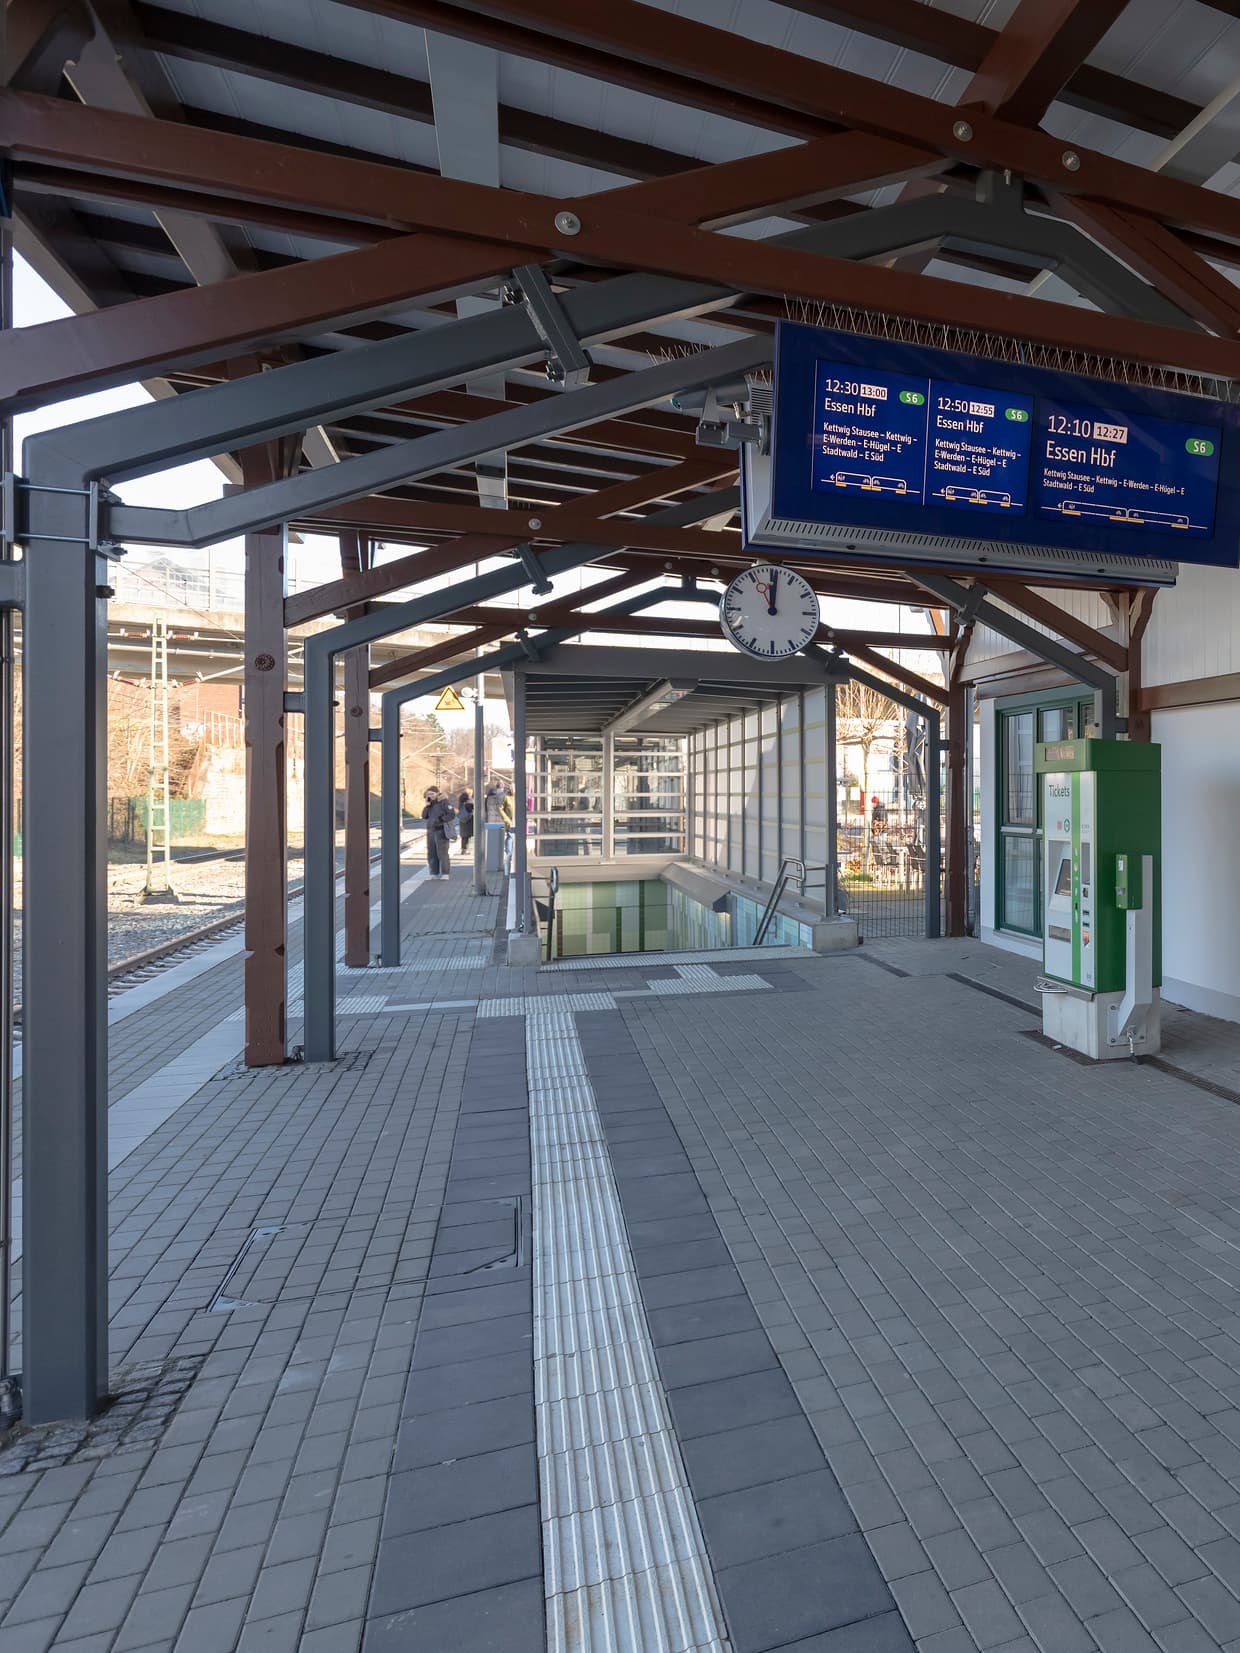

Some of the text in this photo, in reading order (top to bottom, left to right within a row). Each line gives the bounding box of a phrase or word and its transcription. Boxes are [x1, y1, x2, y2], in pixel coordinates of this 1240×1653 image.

[826, 379, 886, 397] 12:30 13:00
[825, 398, 876, 416] Essen Hbf
[938, 398, 992, 415] 12:50 12:55
[824, 423, 850, 435] Kettwig
[852, 426, 878, 438] Stausee
[886, 432, 911, 444] Kettwig
[937, 416, 984, 433] Essen Hbf
[1048, 416, 1124, 439] 12:10 12:27
[824, 434, 856, 446] E-Werden
[864, 440, 889, 452] E-Hügel
[936, 439, 960, 451] Kettwig
[961, 442, 986, 453] Stausee
[993, 448, 1016, 459] Kettwig
[823, 446, 857, 458] Stadtwald
[871, 452, 884, 461] Süd
[935, 450, 965, 461] E-Werden
[972, 455, 995, 466] E-Hügel
[1046, 441, 1116, 467] Essen Hbf
[934, 461, 966, 472] Stadtwald
[978, 466, 990, 476] Süd
[1043, 480, 1072, 490] Stadtwald
[1083, 484, 1094, 493] Süd
[1044, 469, 1066, 480] Kettwig
[1067, 472, 1090, 482] Stausee
[1096, 476, 1117, 488] Kettwig
[1124, 480, 1149, 490] E-Werden
[1155, 484, 1175, 494] E-Hügel
[1049, 784, 1070, 798] Tickets
